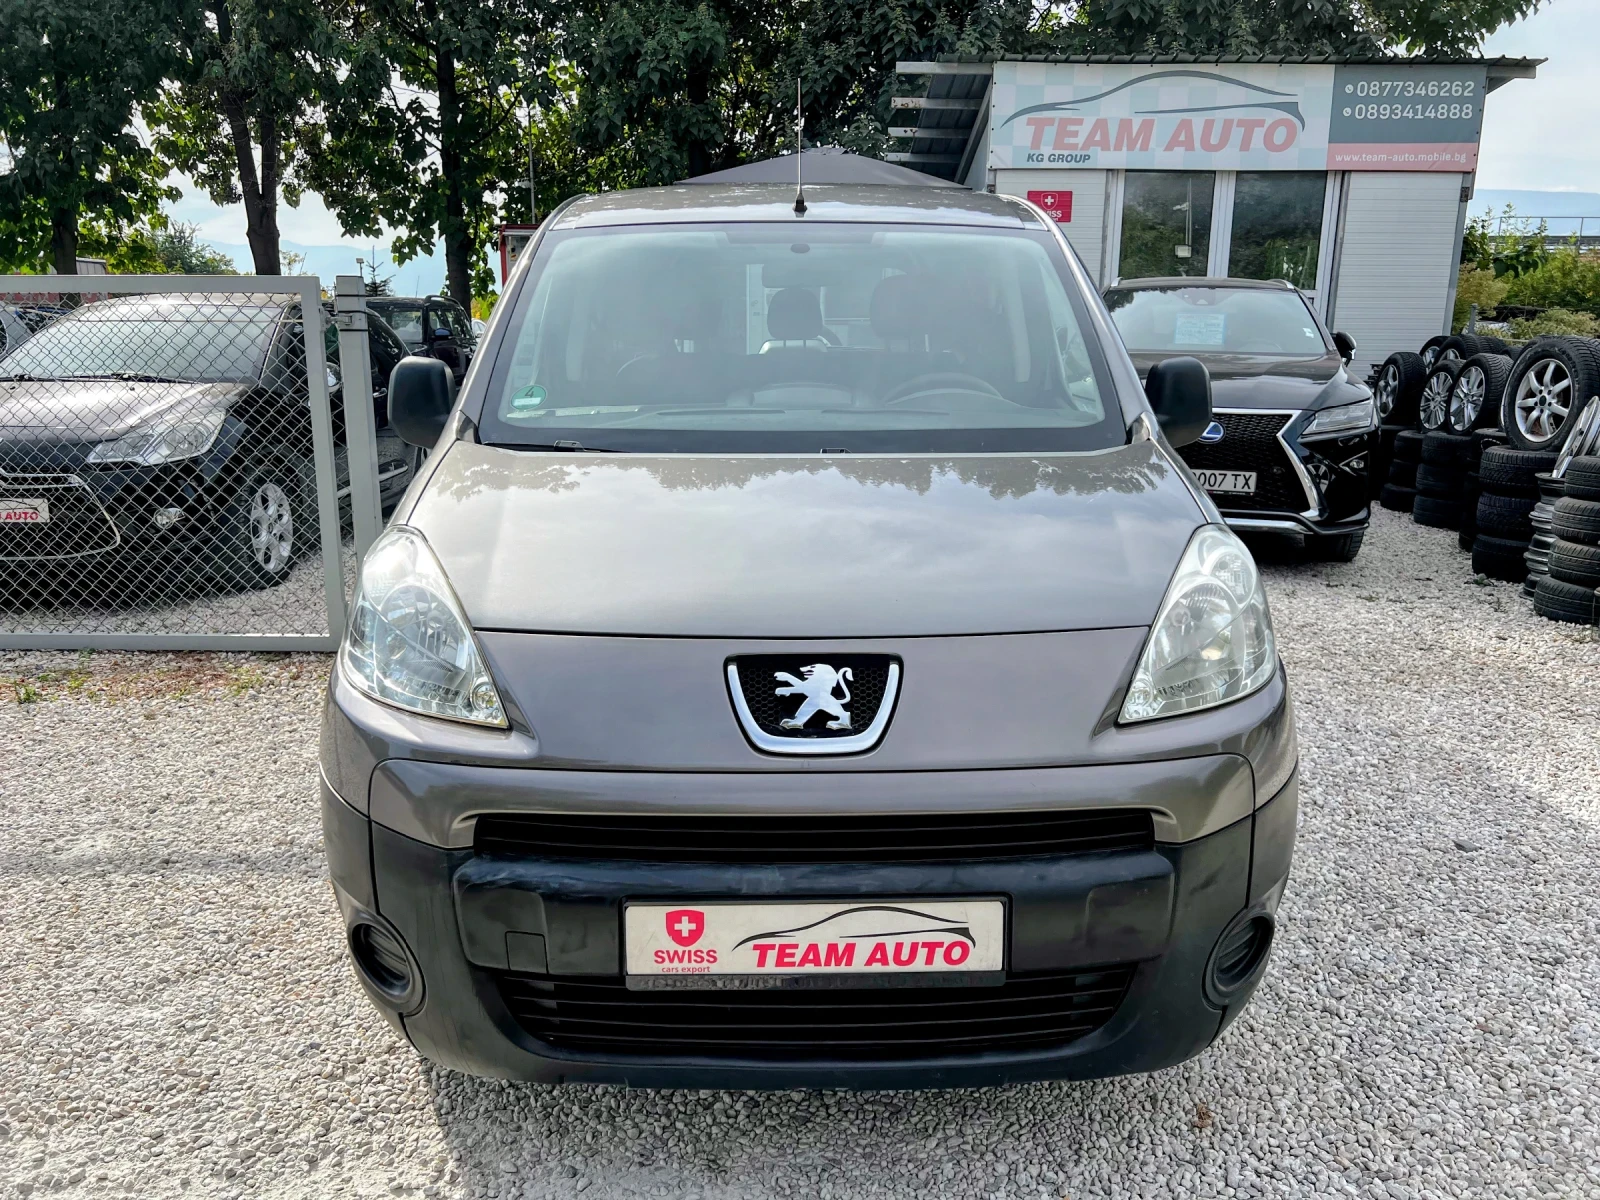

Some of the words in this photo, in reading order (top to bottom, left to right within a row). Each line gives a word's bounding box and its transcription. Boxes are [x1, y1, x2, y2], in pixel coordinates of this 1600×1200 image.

[1356, 81, 1475, 97] 0877346262
[1354, 104, 1473, 119] 0893414888
[1026, 117, 1156, 152] TEAM
[1163, 118, 1298, 152] AUTO
[1027, 153, 1044, 163] KG
[1047, 153, 1091, 163] GROUP
[1335, 152, 1467, 163] www.team-auto.mobile.bg
[524, 386, 535, 398] 4
[1192, 471, 1227, 488] 007
[1231, 474, 1252, 490] TX
[5, 511, 39, 521] AUTO
[653, 949, 718, 964] SWISS
[752, 942, 856, 968] TEAM
[864, 940, 970, 967] AUTO
[681, 966, 711, 975] export
